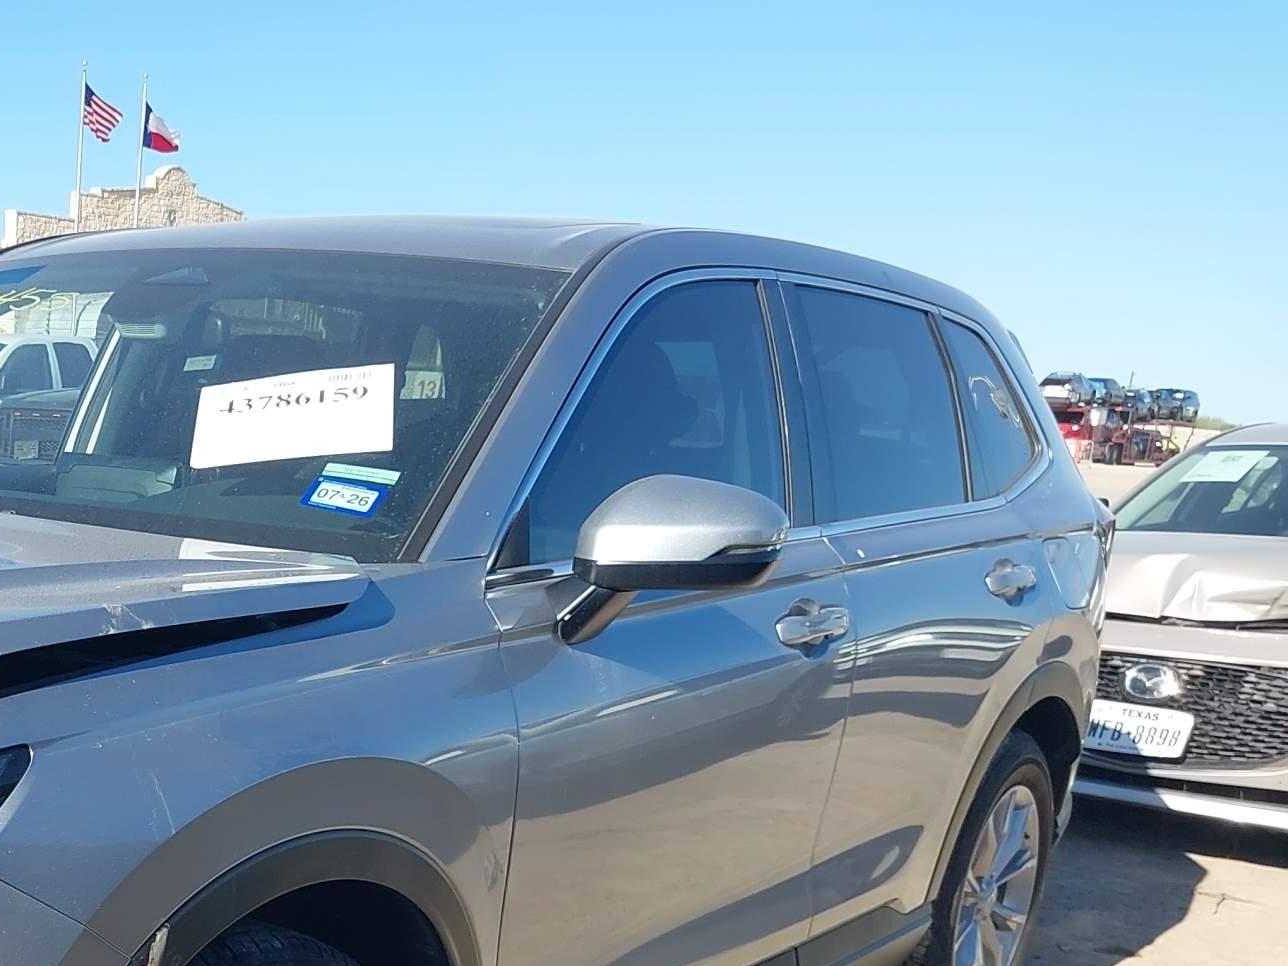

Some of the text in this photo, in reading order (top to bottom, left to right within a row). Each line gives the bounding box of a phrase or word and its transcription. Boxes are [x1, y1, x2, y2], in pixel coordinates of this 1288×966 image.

[417, 380, 437, 399] 13
[219, 385, 368, 414] 43786159
[316, 487, 341, 501] 07
[346, 493, 371, 507] 26
[1121, 708, 1160, 721] TEXAS
